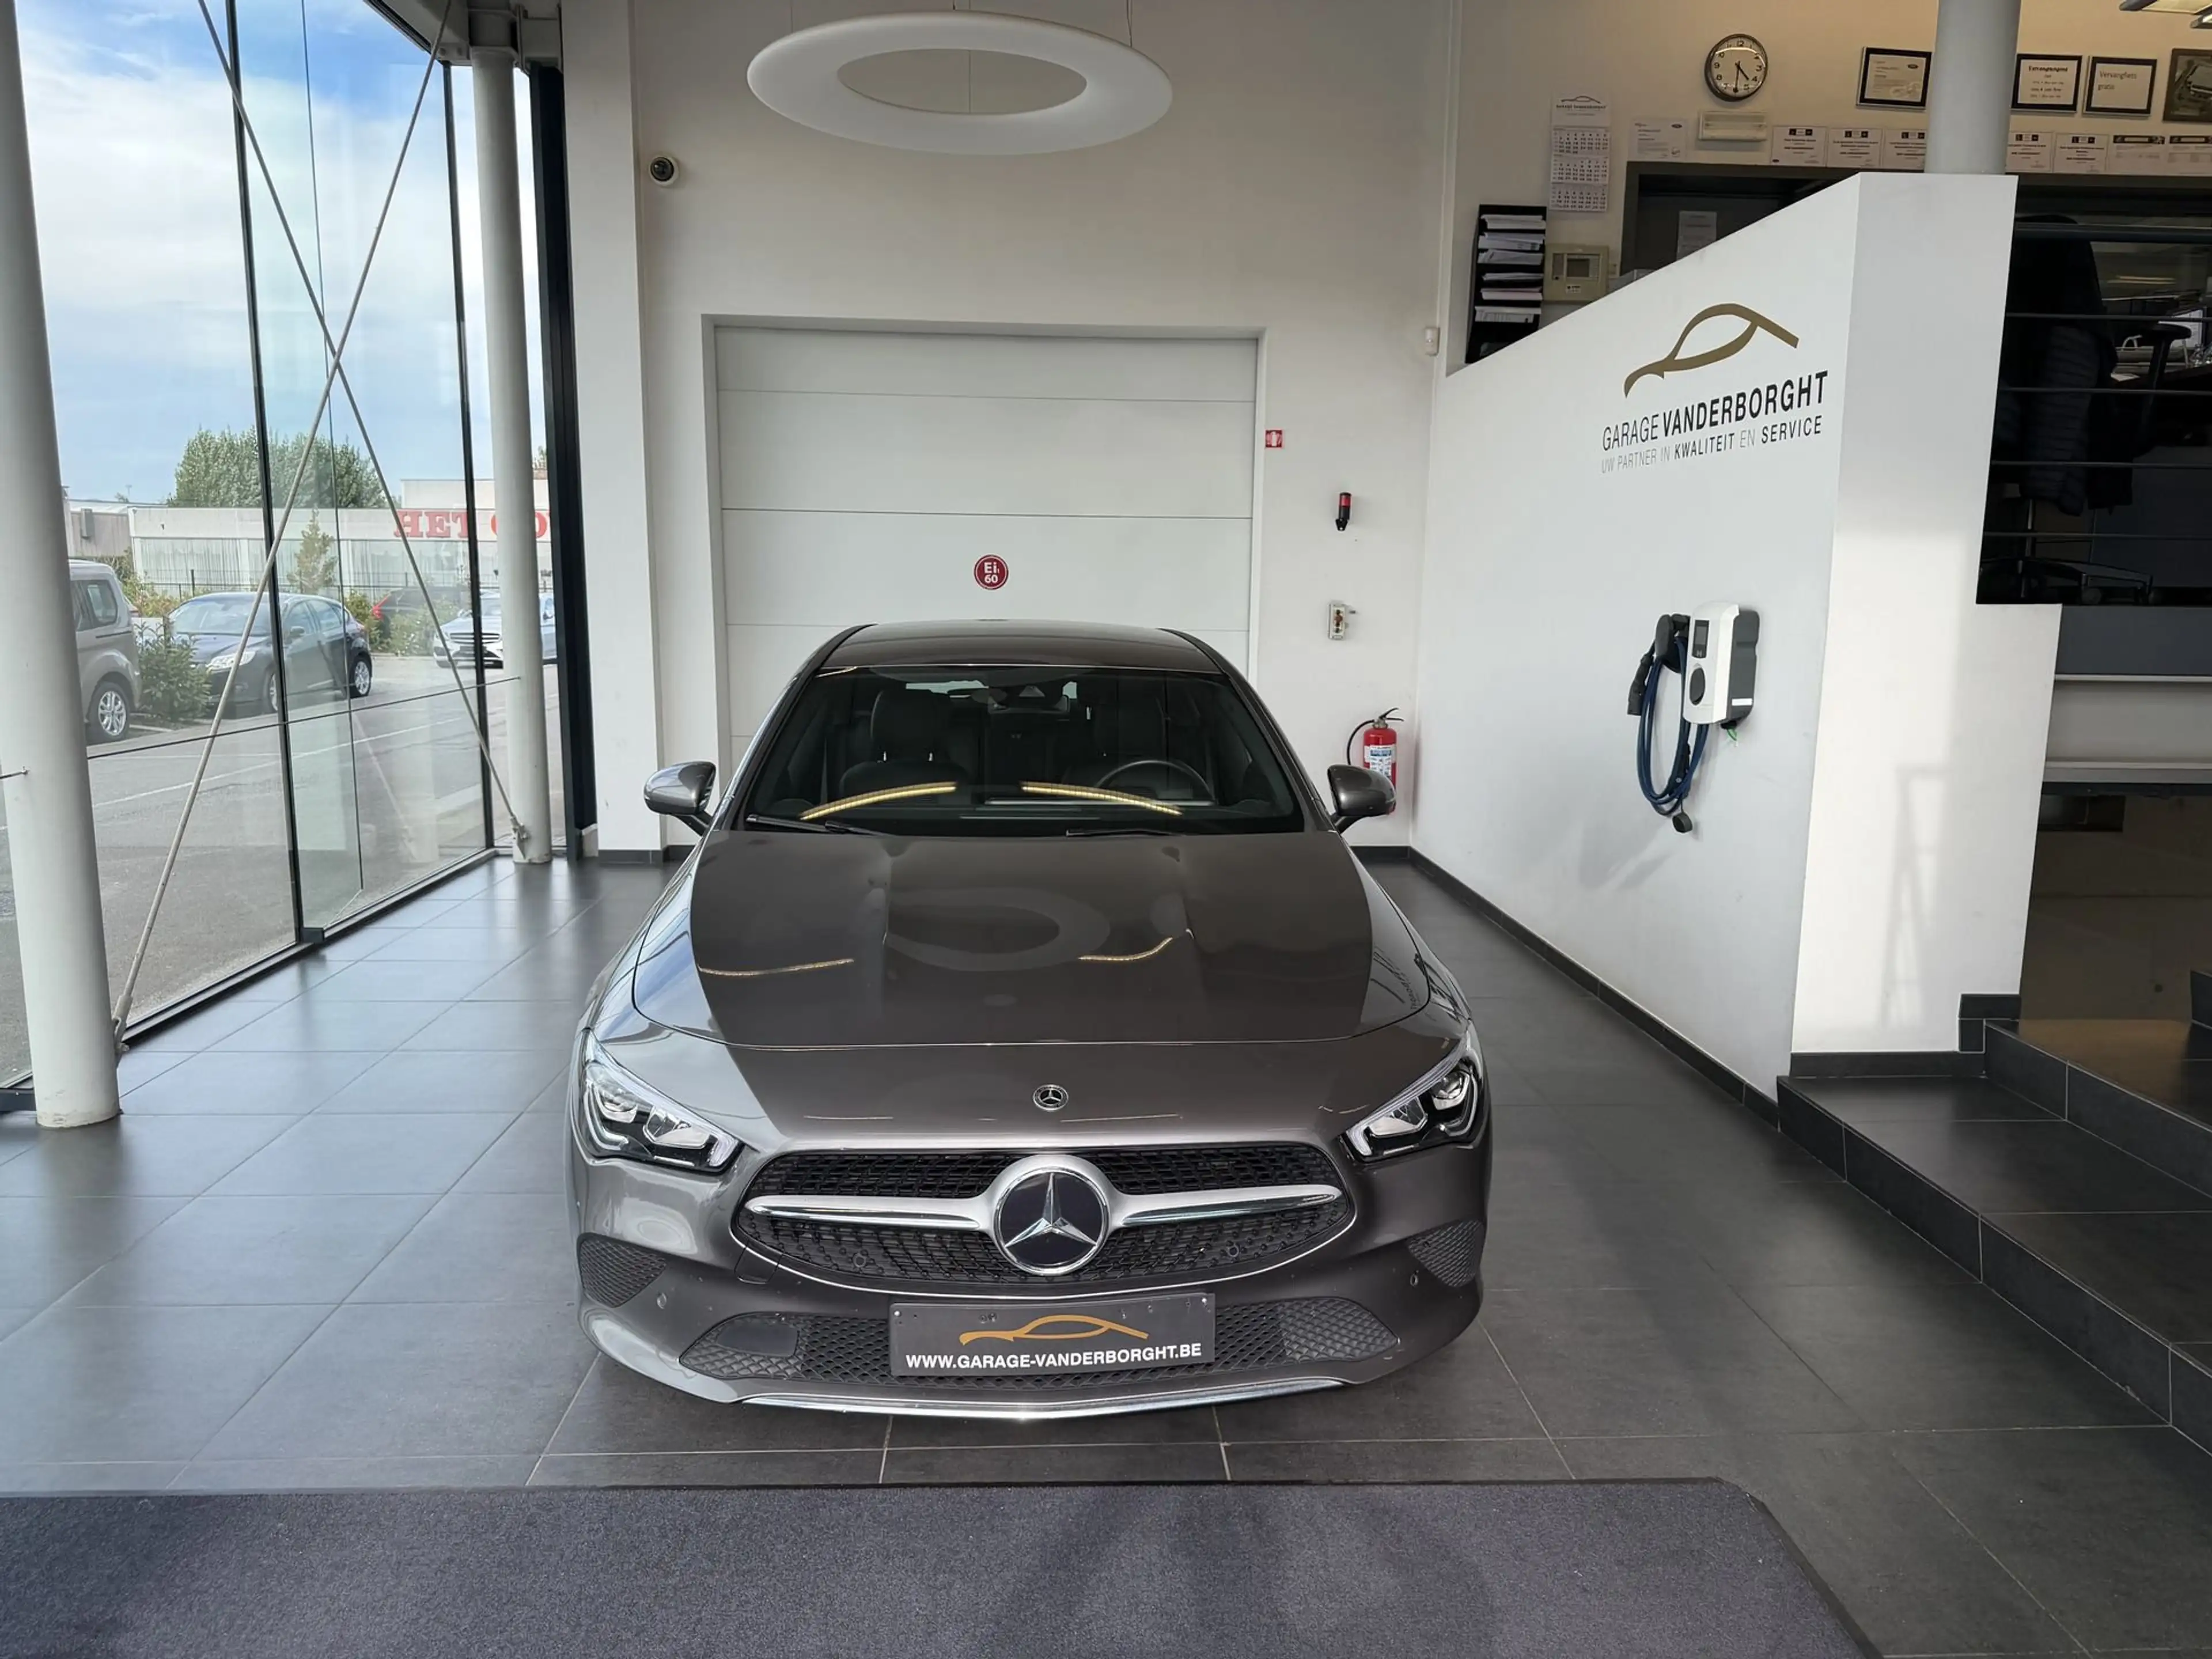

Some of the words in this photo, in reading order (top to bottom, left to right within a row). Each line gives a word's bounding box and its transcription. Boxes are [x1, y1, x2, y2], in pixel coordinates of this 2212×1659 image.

[1603, 414, 1658, 450] GARAGE
[1664, 370, 1828, 437] VANDERBORGHT
[1601, 458, 1614, 473] UW
[1618, 448, 1657, 471] PARTNER
[1661, 446, 1671, 461] IN
[1674, 433, 1734, 460] KWALITEIT
[1740, 429, 1755, 448] EN
[1762, 415, 1822, 444] SERVICE
[984, 574, 998, 584] 60
[906, 1343, 1202, 1369] WWW.GARAGE-VANDERBORGHT.BE
